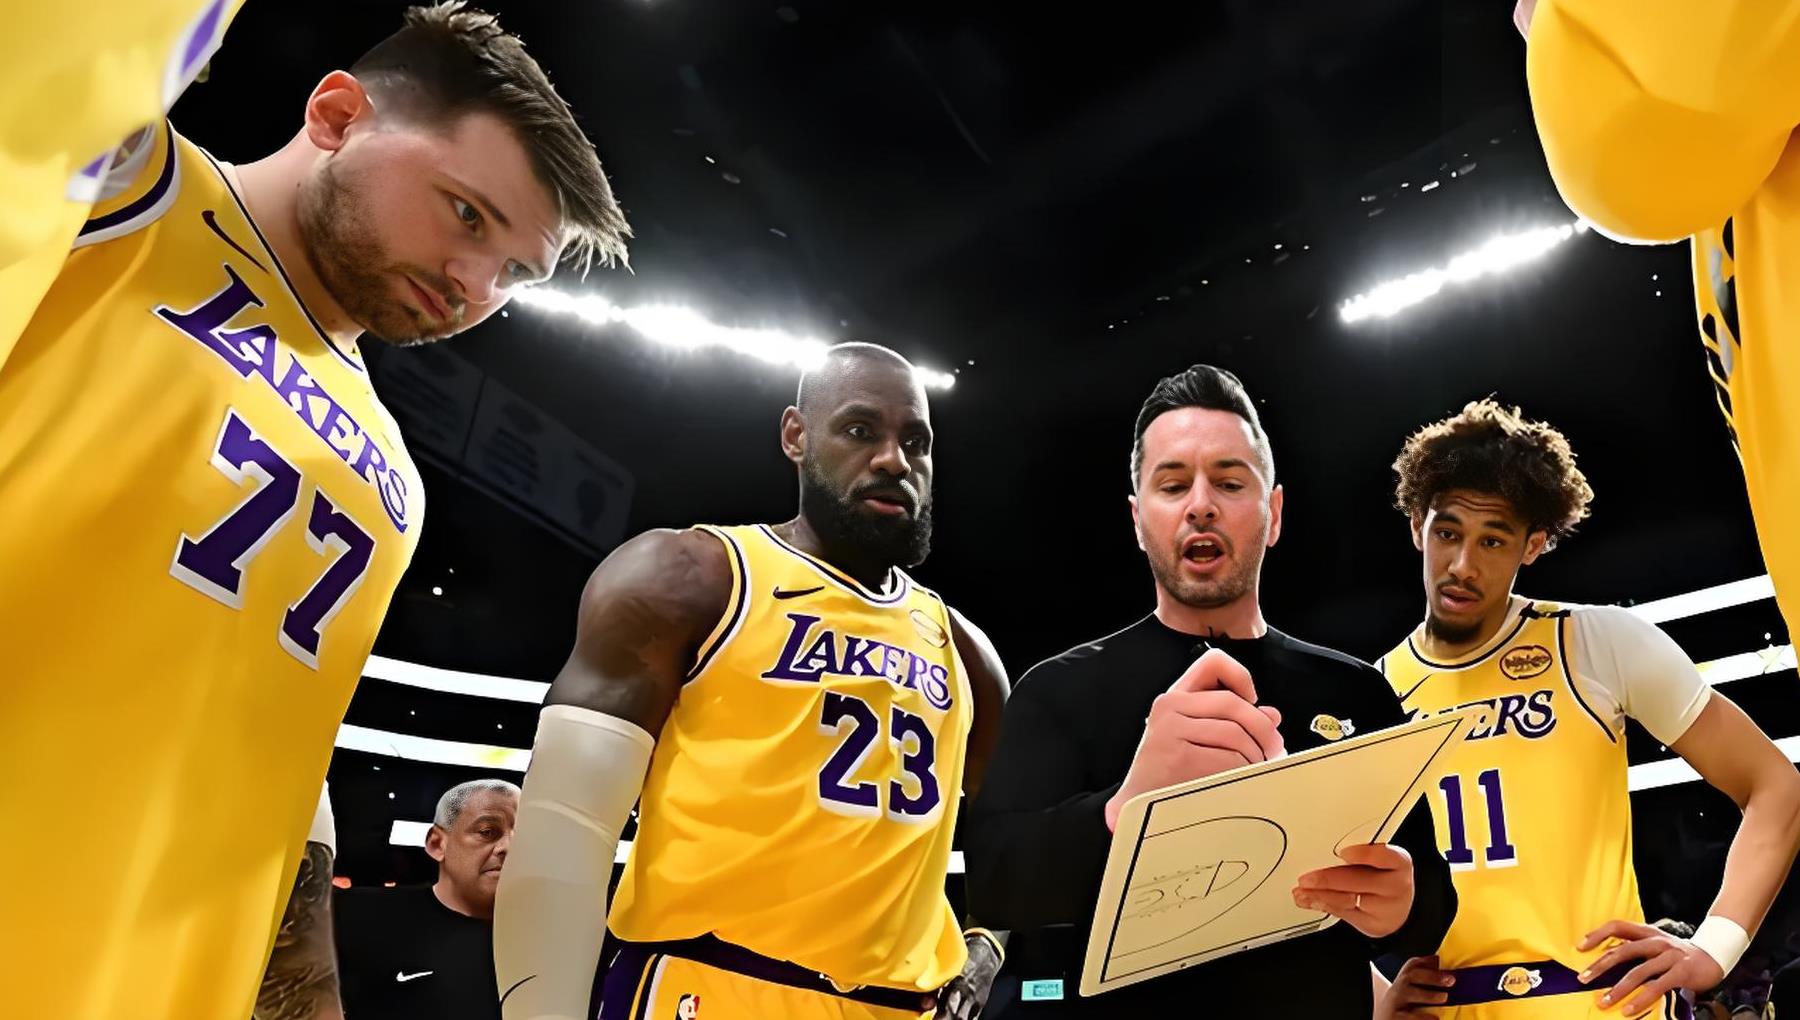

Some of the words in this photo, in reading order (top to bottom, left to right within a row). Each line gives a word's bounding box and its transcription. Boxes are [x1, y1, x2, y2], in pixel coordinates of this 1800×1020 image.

[153, 263, 408, 534] LAKERS
[172, 407, 375, 666] 77
[760, 612, 954, 711] LAKERS
[818, 690, 941, 820] 23
[1438, 768, 1517, 868] 11
